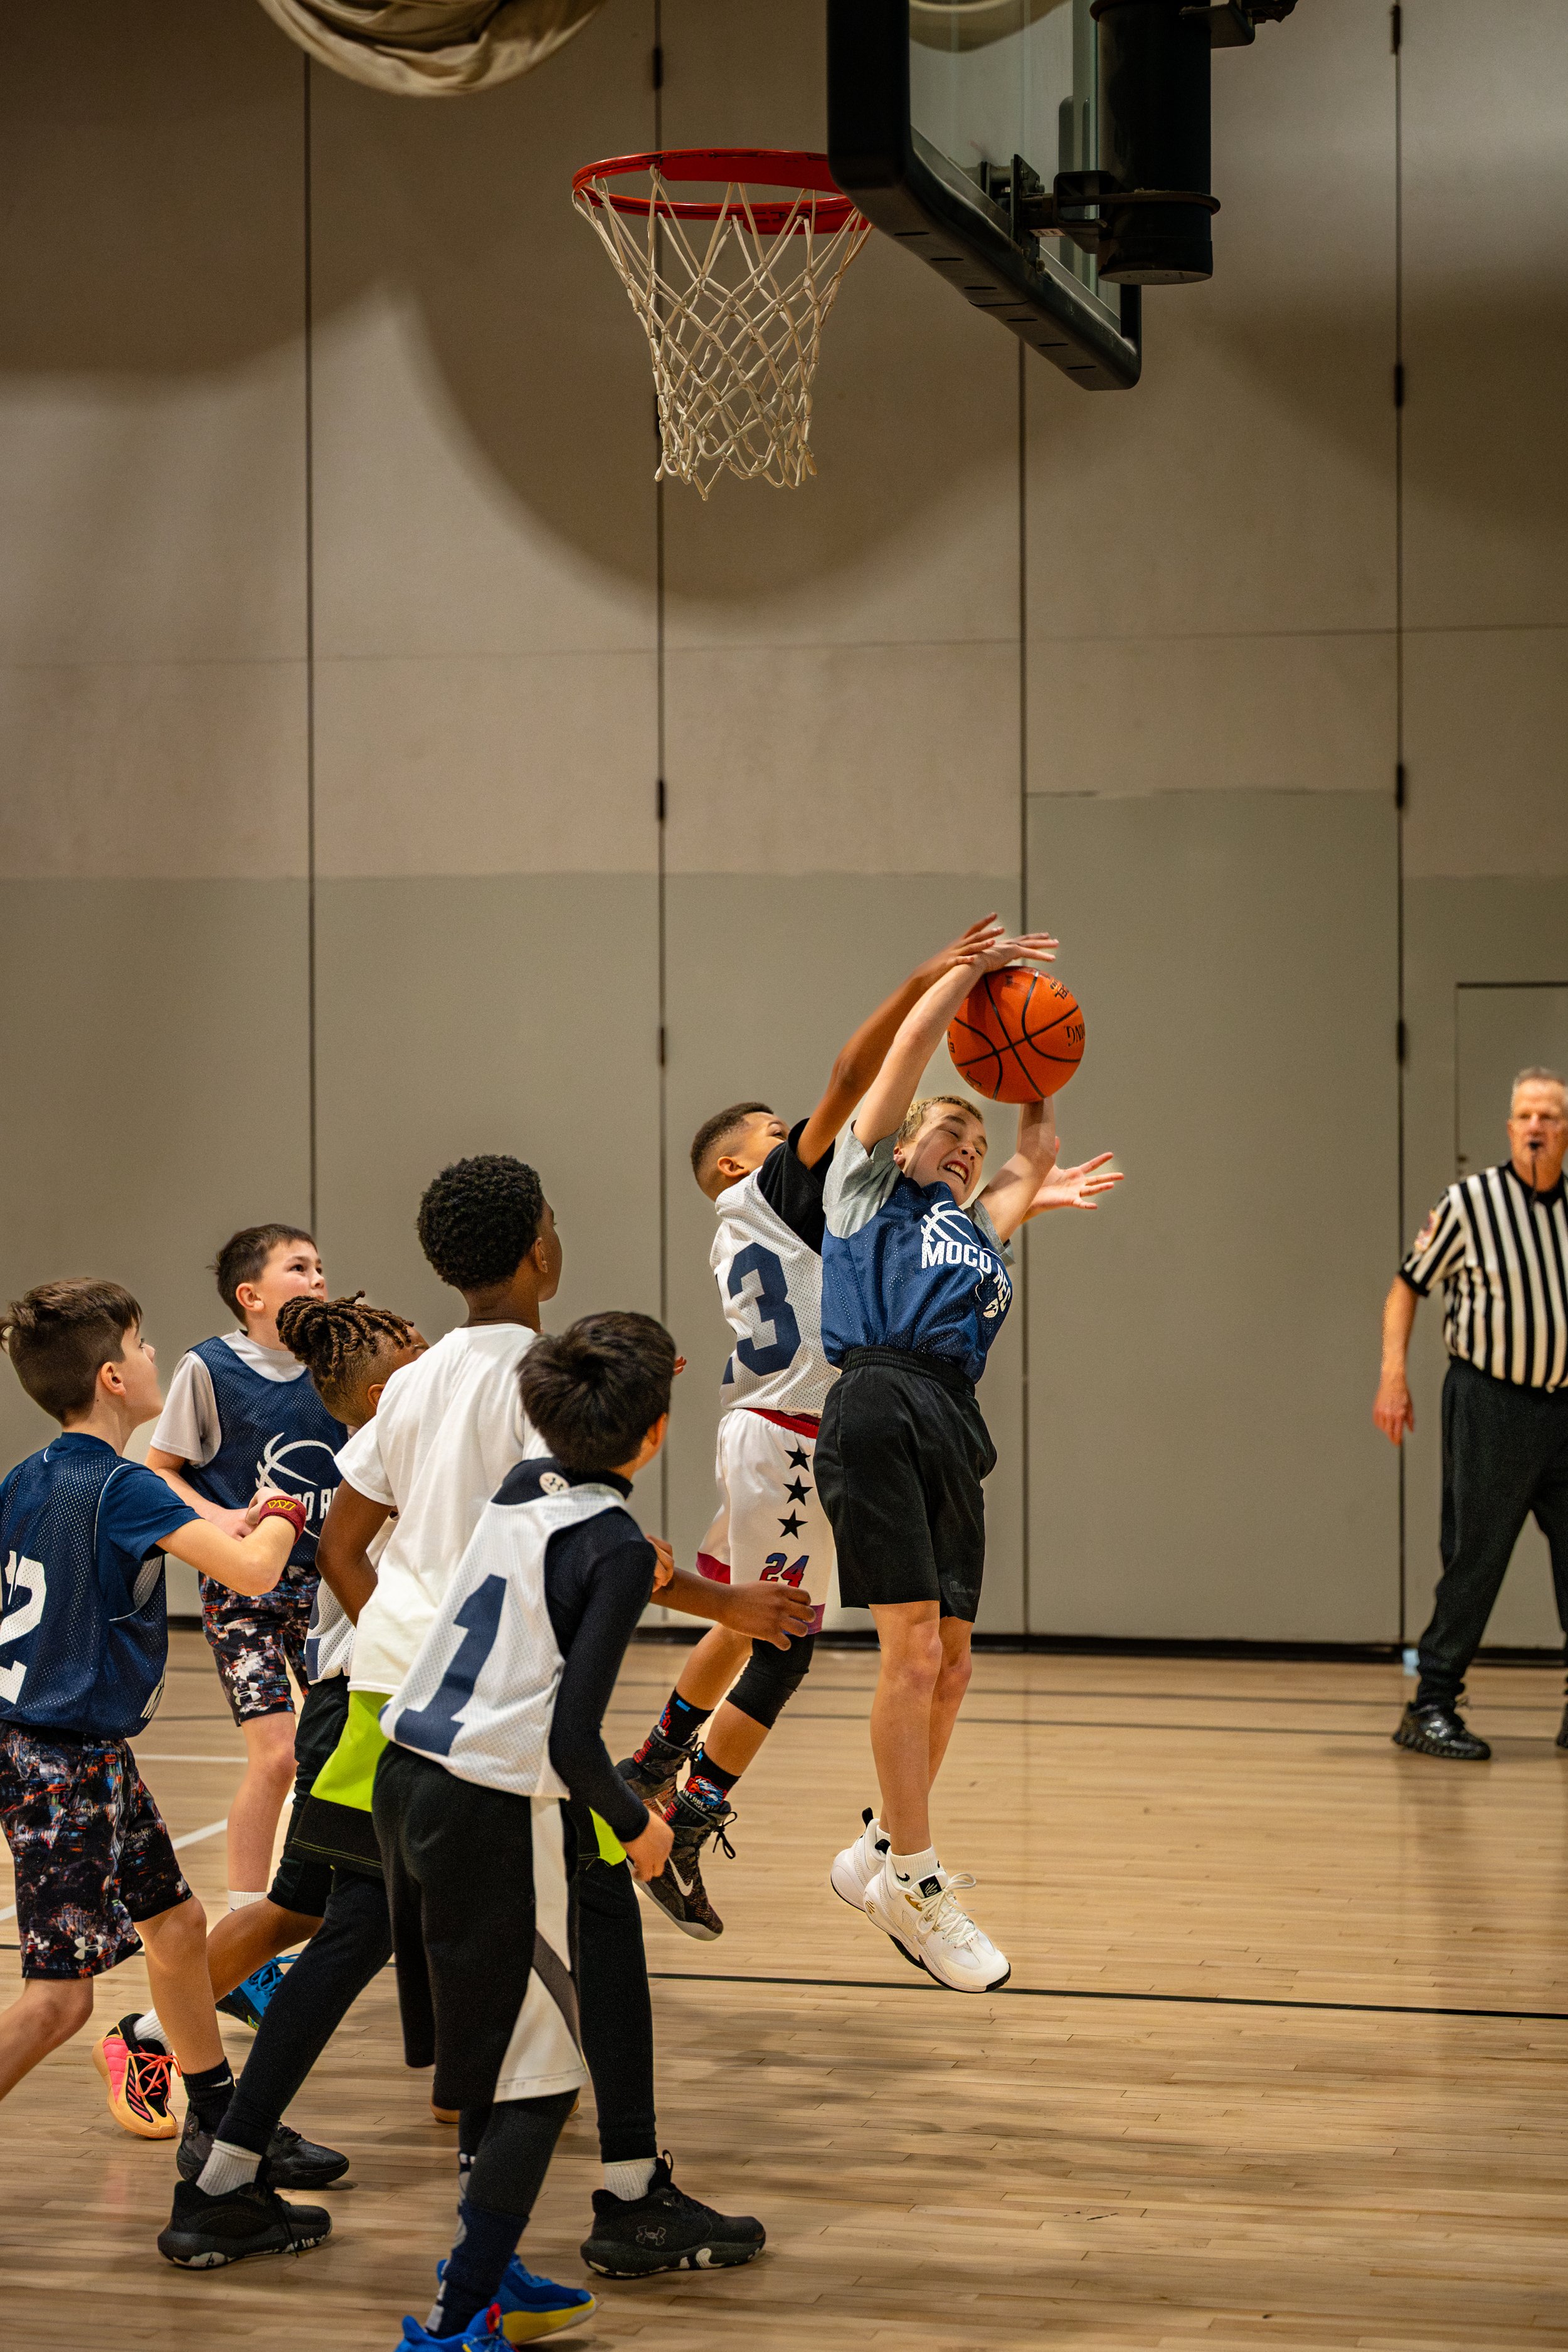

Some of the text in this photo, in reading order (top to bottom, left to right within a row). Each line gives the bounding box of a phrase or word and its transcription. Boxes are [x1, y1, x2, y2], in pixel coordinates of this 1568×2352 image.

[921, 1241, 992, 1274] MOCO
[722, 1242, 802, 1385] 3
[759, 1552, 810, 1588] 24
[378, 1574, 507, 1757] 1
